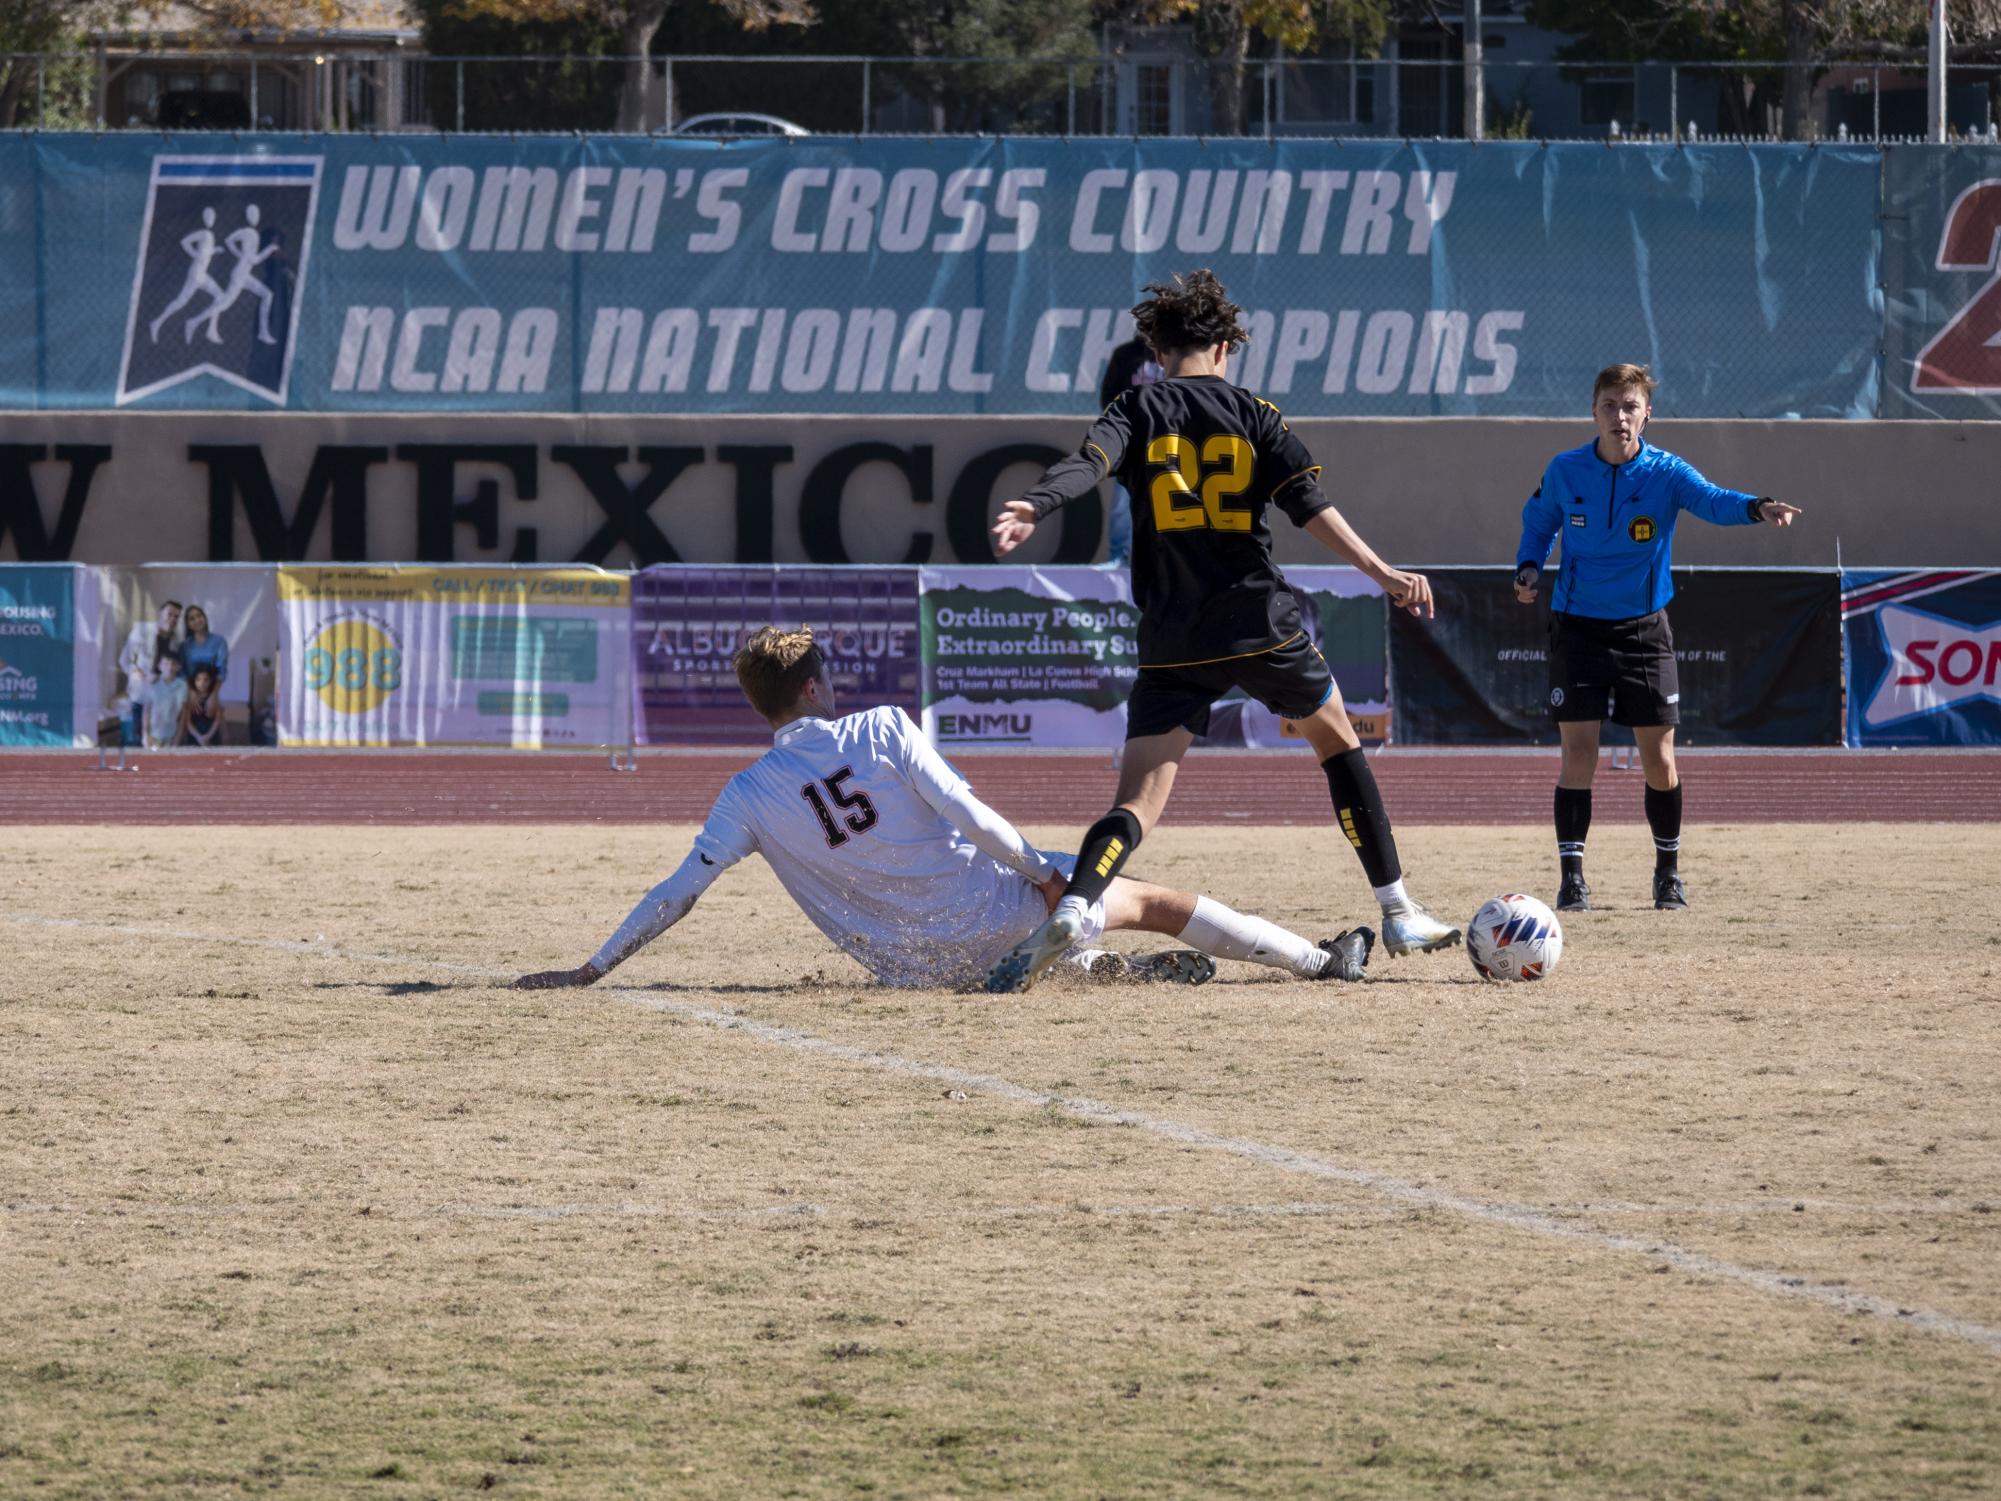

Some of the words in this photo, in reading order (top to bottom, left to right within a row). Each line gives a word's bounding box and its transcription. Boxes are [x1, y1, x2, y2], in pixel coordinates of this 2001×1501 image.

[333, 164, 749, 253] WOMEN'S
[770, 167, 1047, 254] CROSS
[1069, 168, 1458, 256] COUNTRY
[330, 304, 559, 394] NCAA
[580, 306, 994, 395] NATIONAL
[1146, 434, 1253, 533] 22
[187, 441, 1104, 565] MEXICO
[432, 577, 471, 592] CALL
[936, 607, 1047, 632] Ordinary
[1052, 608, 1136, 633] People.
[937, 635, 1107, 660] Extraordinary
[1498, 650, 1548, 661] OFFICIAL
[1687, 651, 1701, 662] OF
[1705, 651, 1727, 662] THE
[304, 646, 401, 692] 988
[936, 666, 963, 677] Cruz
[967, 664, 1019, 677] Markham
[1029, 666, 1042, 676] La
[1084, 665, 1111, 680] High
[938, 680, 953, 690] 1st
[958, 680, 988, 690] Team
[992, 679, 1008, 690] All
[1012, 679, 1040, 690] State
[1051, 679, 1098, 690] Football
[938, 714, 1031, 735] ENMU
[801, 765, 879, 849] 15
